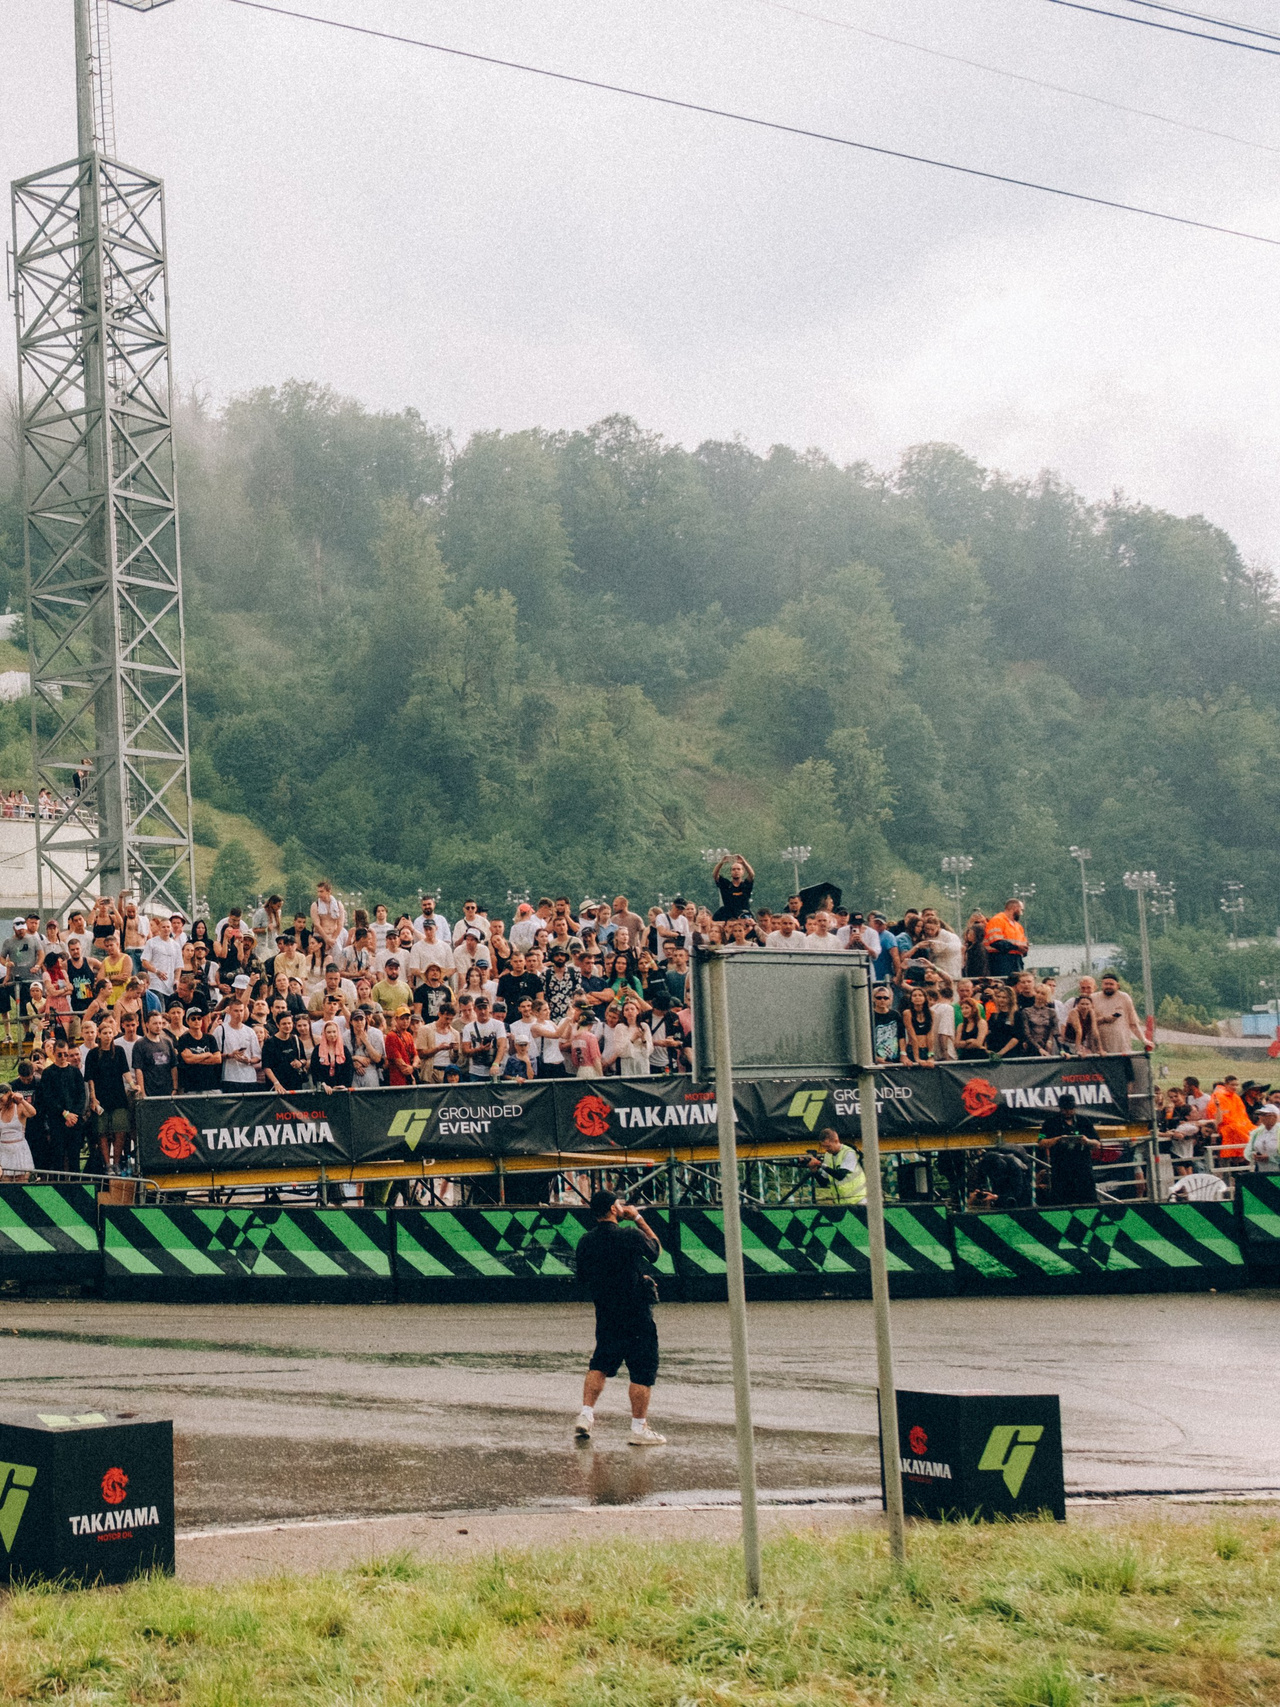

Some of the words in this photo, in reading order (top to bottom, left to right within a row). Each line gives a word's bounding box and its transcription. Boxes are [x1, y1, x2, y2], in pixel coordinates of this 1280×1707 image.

[684, 1092, 716, 1101] MOTOR
[833, 1086, 913, 1102] GRONDED
[275, 1111, 310, 1121] MOTOR
[311, 1110, 328, 1119] OIL
[437, 1104, 523, 1120] GROUNDED
[614, 1103, 739, 1128] TAKAYAM
[834, 1101, 884, 1116] EVET
[438, 1120, 491, 1135] EVENT
[201, 1121, 335, 1150] TAKAYAMA
[69, 1505, 160, 1536] TAKAYAMA
[97, 1532, 121, 1542] MOTOR
[122, 1531, 133, 1539] OIL
